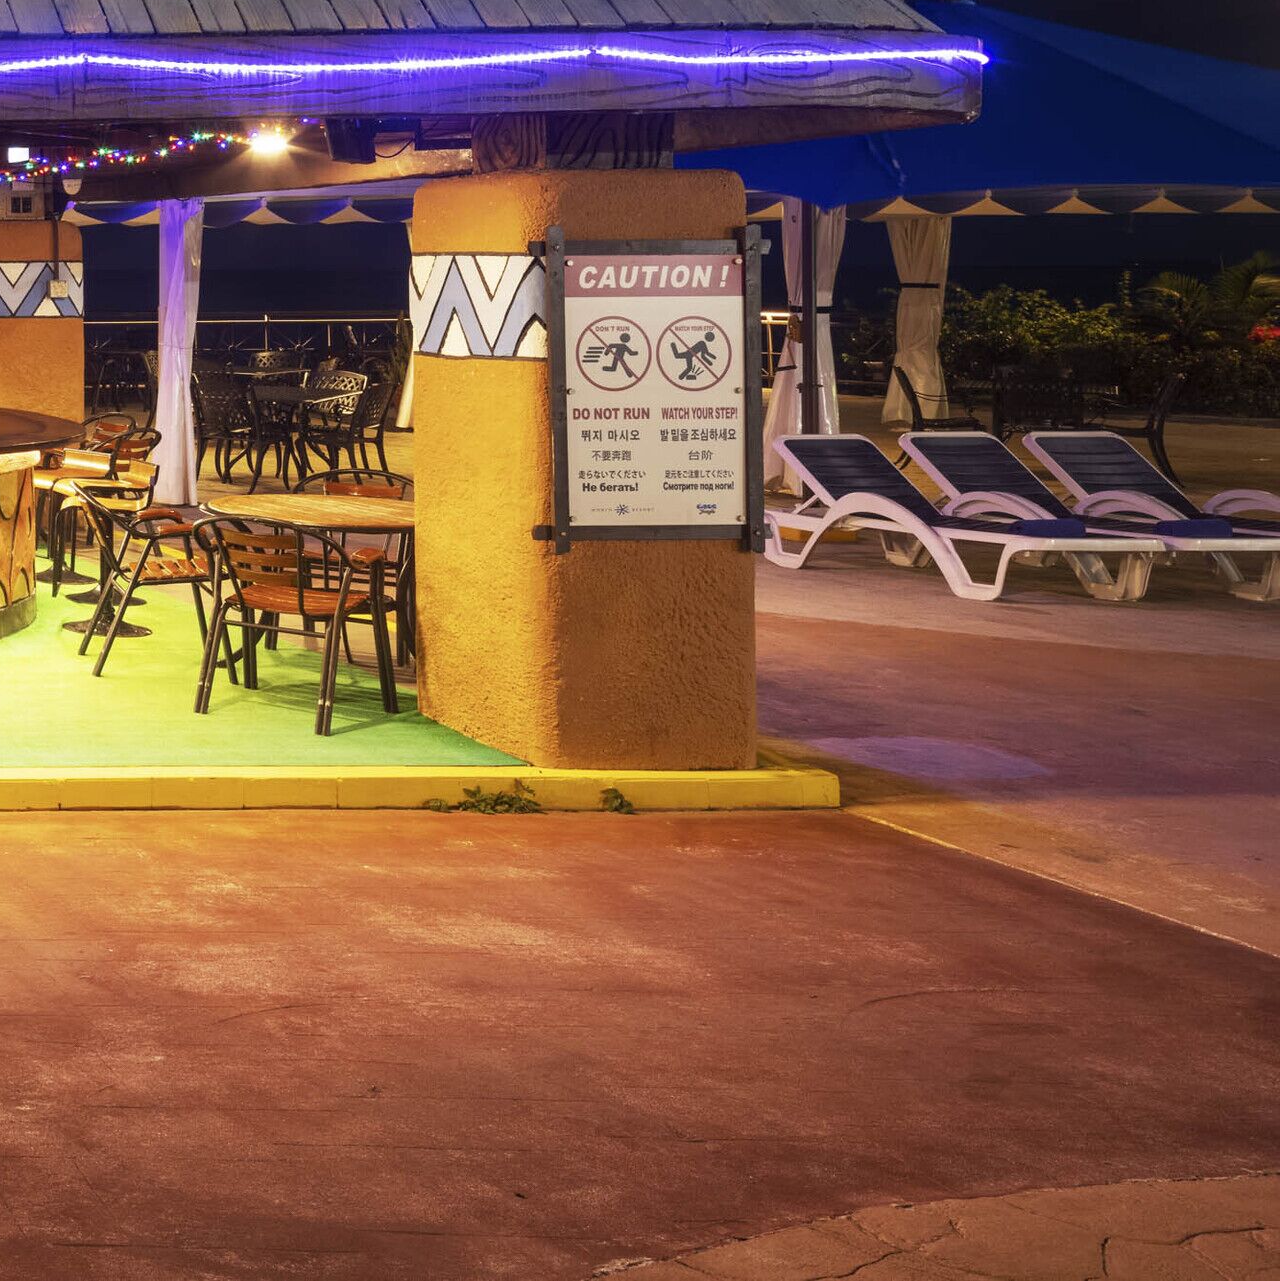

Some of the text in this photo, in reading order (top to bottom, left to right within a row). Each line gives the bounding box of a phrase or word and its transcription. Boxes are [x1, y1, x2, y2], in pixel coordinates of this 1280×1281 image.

[579, 265, 713, 289] CAUTION
[573, 408, 650, 420] DO NOT RUN
[661, 407, 738, 420] WATCH YOUR STEP!
[608, 429, 641, 442] 마시오
[592, 450, 632, 461] 不要奔跑
[688, 450, 713, 461] 台阶
[578, 470, 646, 479] 走らないでください
[582, 482, 639, 492] Не бегать!
[663, 482, 698, 493] Смотрите
